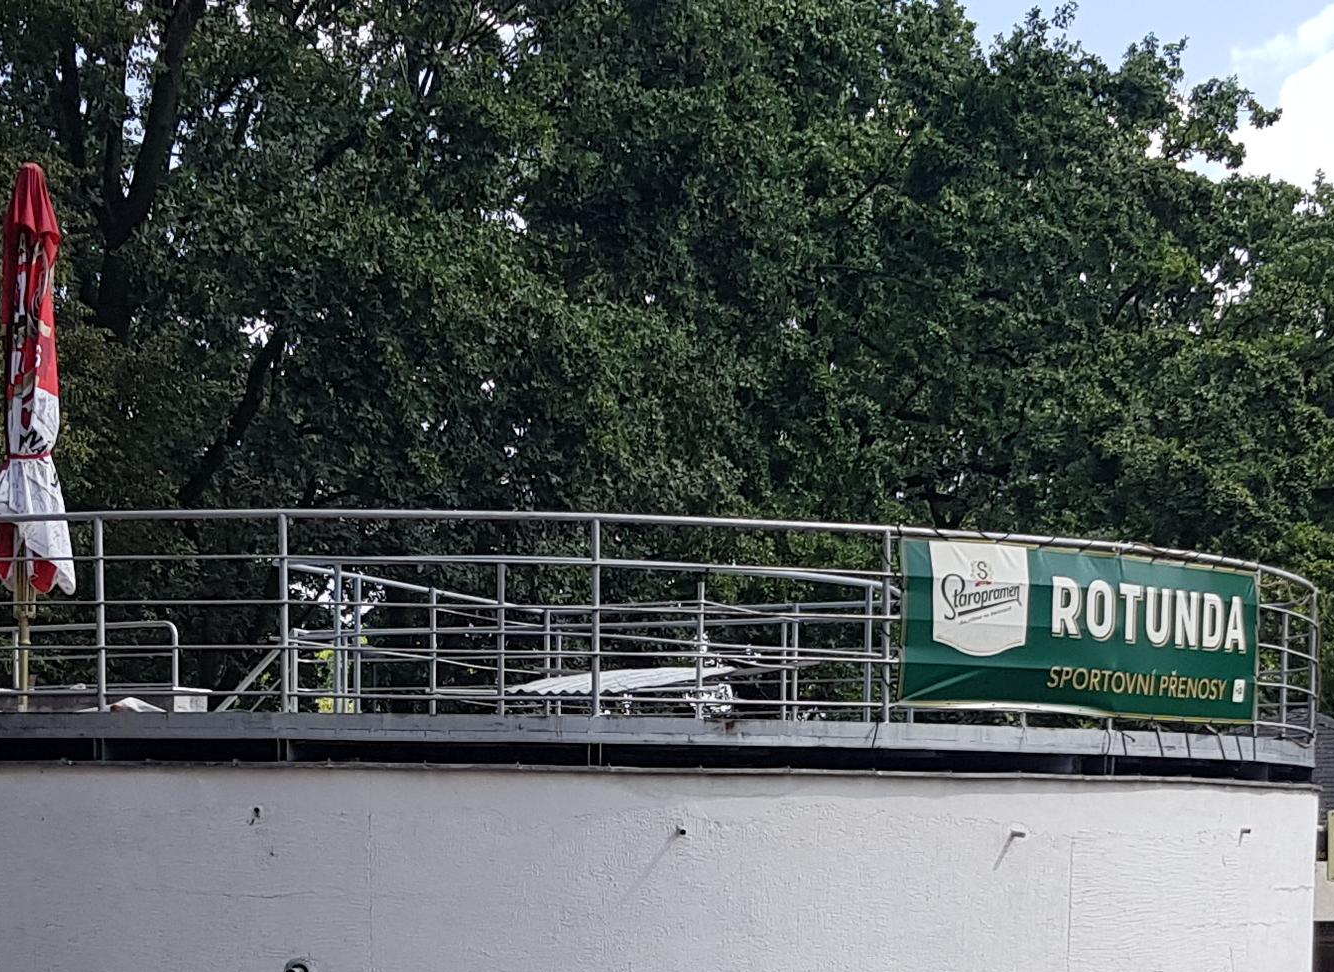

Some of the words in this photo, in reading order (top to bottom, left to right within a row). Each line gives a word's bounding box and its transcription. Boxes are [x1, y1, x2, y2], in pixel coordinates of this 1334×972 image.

[941, 573, 1022, 620] Staropramen
[1051, 575, 1247, 654] ROTUNDA
[1047, 665, 1157, 697] SPORTOVNÍ
[1158, 670, 1227, 700] PŘENOSY
